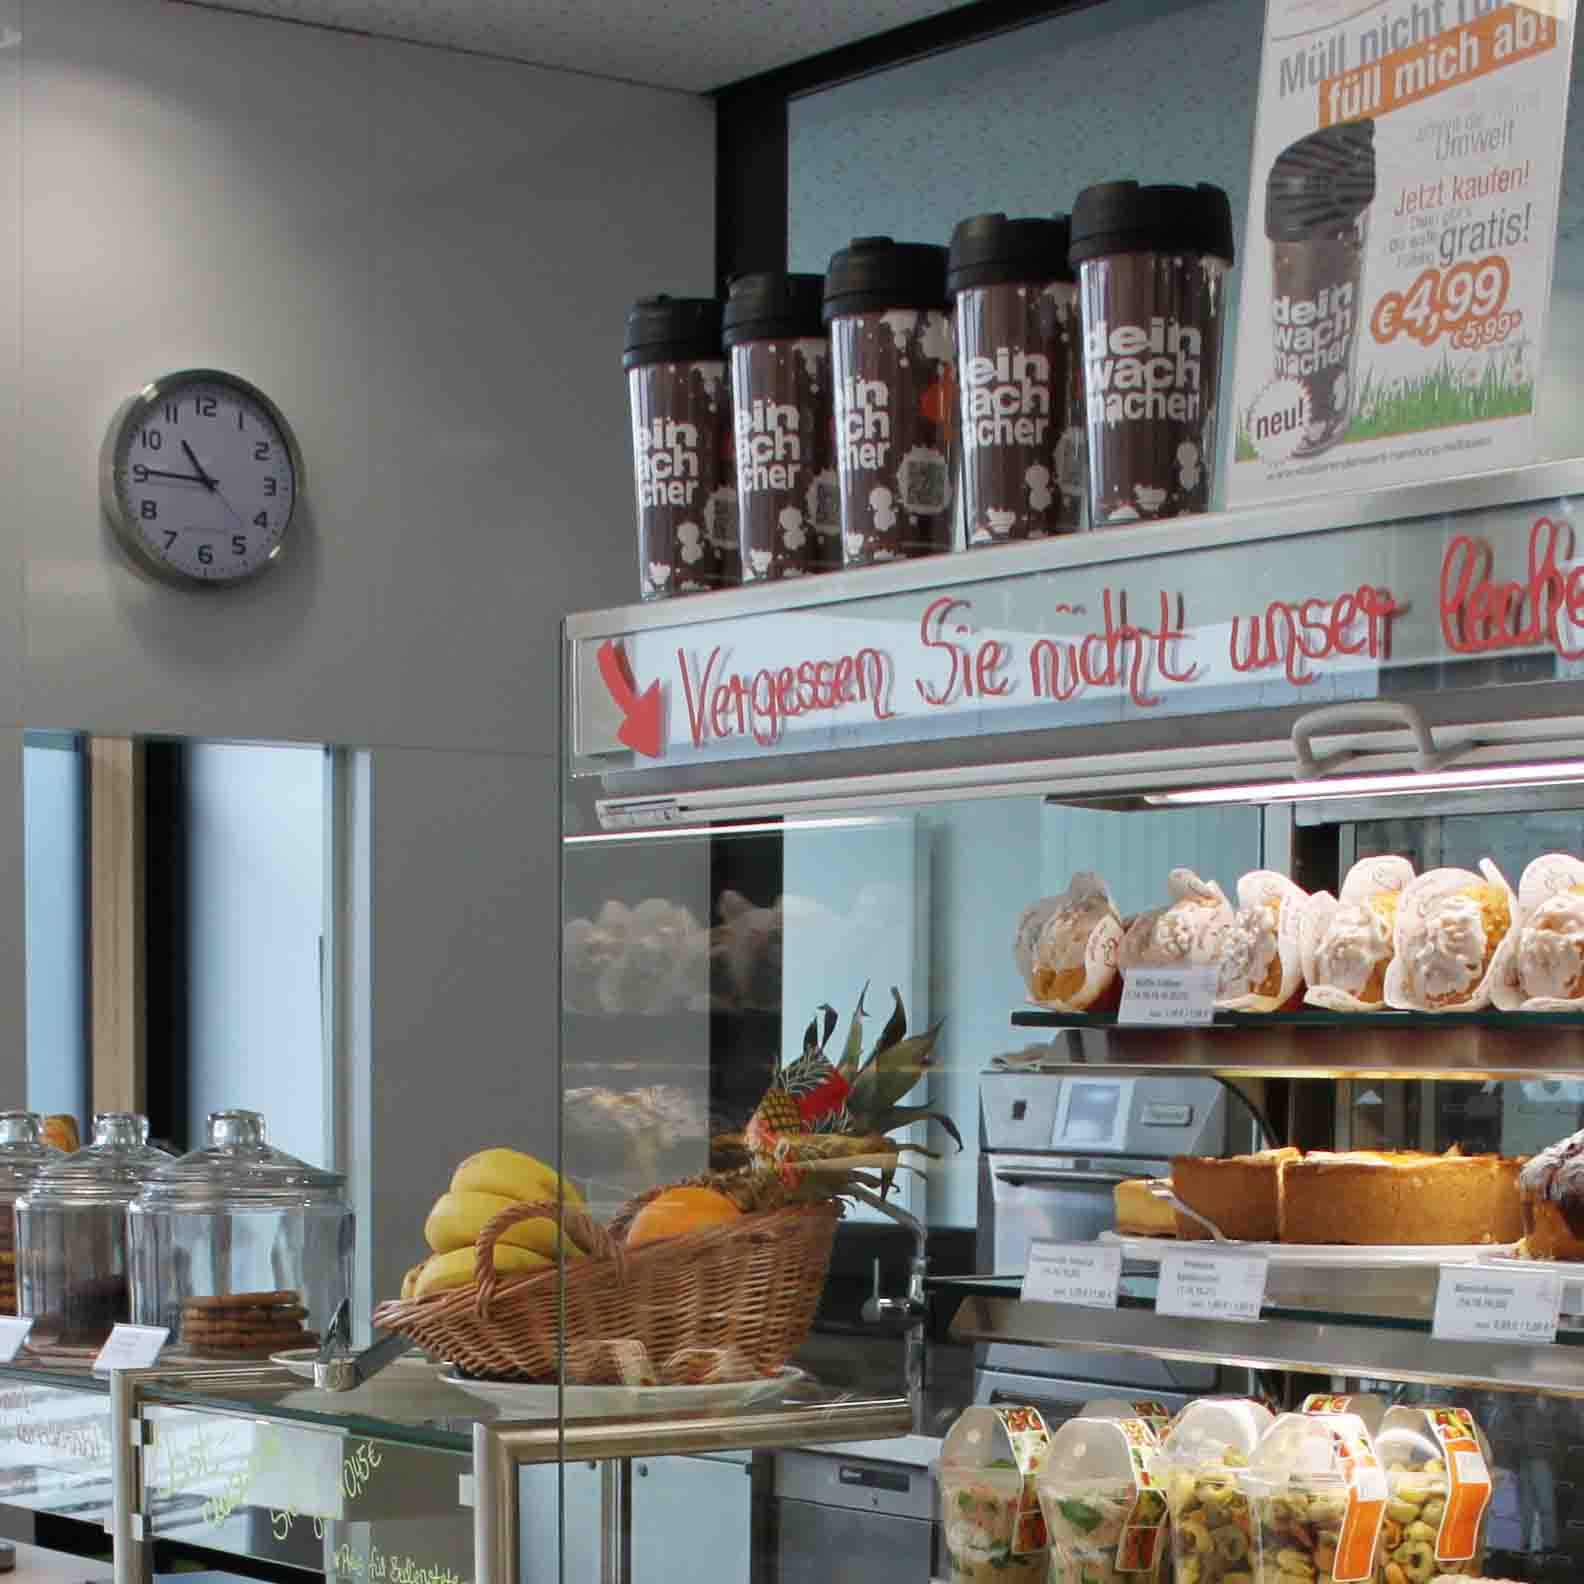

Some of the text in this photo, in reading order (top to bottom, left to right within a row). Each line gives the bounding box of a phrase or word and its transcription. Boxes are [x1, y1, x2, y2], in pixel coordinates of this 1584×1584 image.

[1279, 31, 1345, 99] Müll
[1327, 63, 1382, 124] füll
[1393, 31, 1479, 99] mich
[1492, 8, 1551, 59] ab!
[1394, 160, 1531, 217] Jetzt kaufen!
[1440, 202, 1532, 266] gratis!
[1273, 282, 1354, 325] dein
[1275, 308, 1354, 352] wach
[166, 404, 179, 424] 11
[195, 396, 217, 417] 12
[1256, 399, 1305, 440] neu!
[142, 429, 161, 451] 10
[254, 441, 270, 461] 2
[133, 464, 149, 483] 9
[264, 477, 277, 497] 3
[141, 500, 157, 520] 8
[253, 511, 268, 528] 4
[163, 530, 178, 550] 7
[231, 535, 247, 555] 5
[198, 544, 214, 565] 6
[678, 643, 895, 747] Vergessen
[915, 597, 1009, 706] Sie
[1029, 588, 1198, 706] nicht
